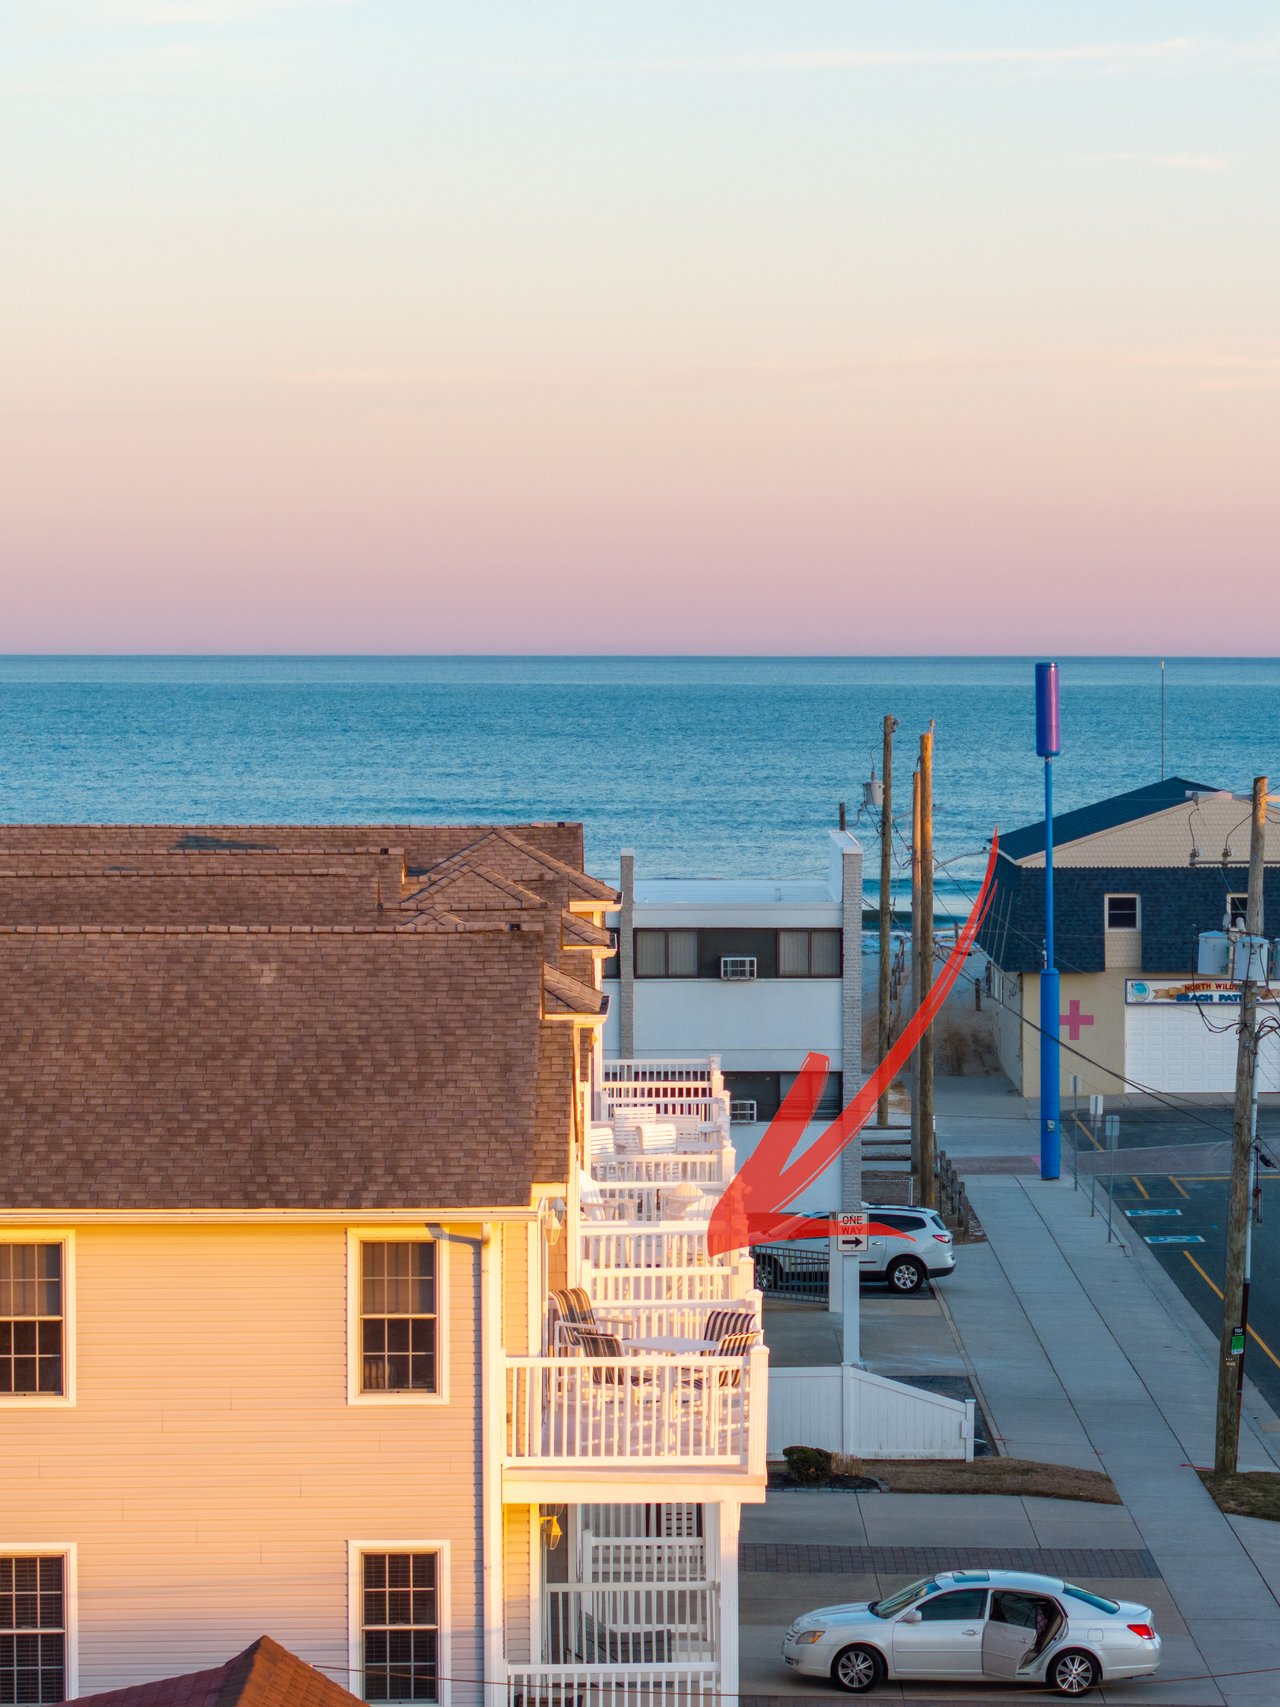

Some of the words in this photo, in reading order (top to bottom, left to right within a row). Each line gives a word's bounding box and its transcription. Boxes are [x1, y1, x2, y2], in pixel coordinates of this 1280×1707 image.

[1184, 983, 1211, 992] NORTH
[1215, 982, 1237, 990] WILD
[842, 1215, 863, 1224] ONE
[841, 1226, 863, 1235] WAY
